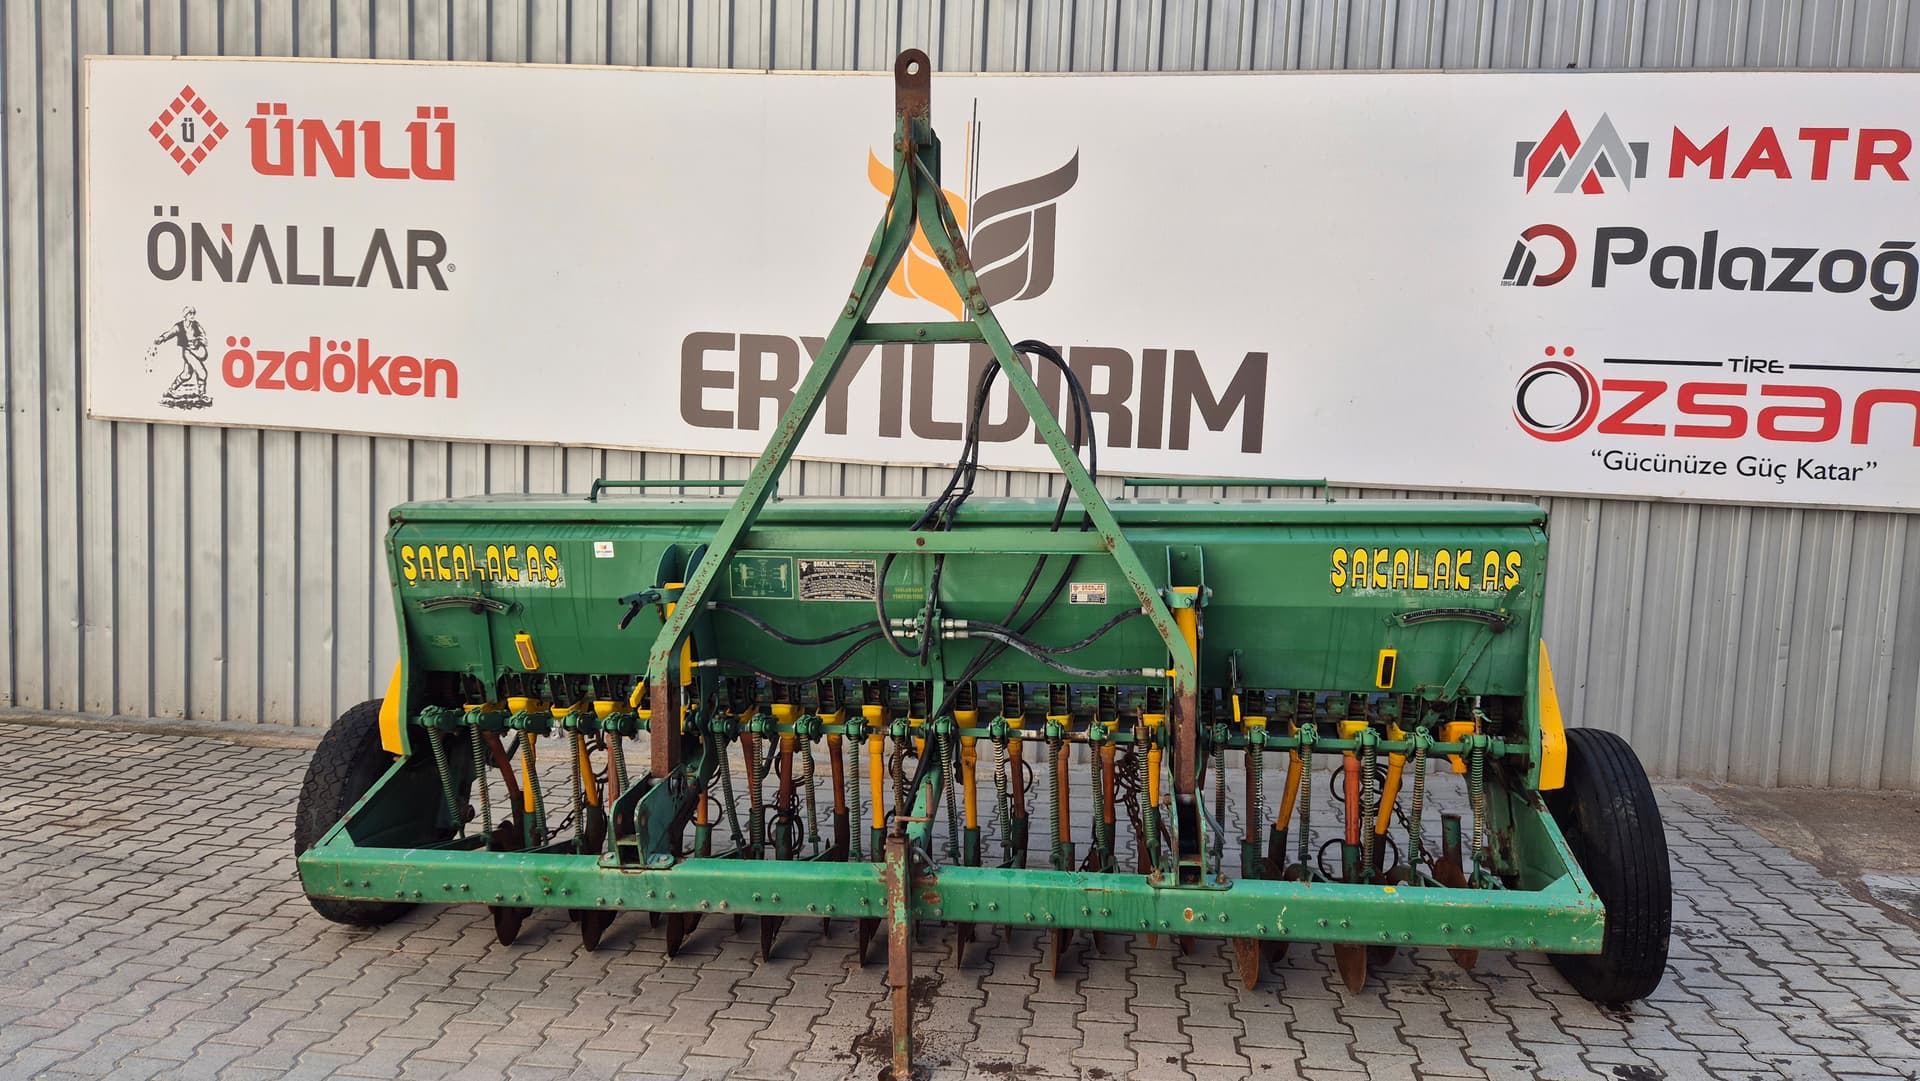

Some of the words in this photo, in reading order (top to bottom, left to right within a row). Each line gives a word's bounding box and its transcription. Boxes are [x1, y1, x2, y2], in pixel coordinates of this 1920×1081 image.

[245, 102, 455, 180] ÜNLÜ
[1668, 125, 1912, 182] MATR
[221, 335, 458, 399] özdöken
[1728, 356, 1785, 373] TİRE
[680, 331, 1269, 454] ERYILDIRIM
[1736, 455, 1787, 484] Güç
[400, 543, 520, 587] ŞAKALAK
[1330, 547, 1473, 593] ŞAKALAK
